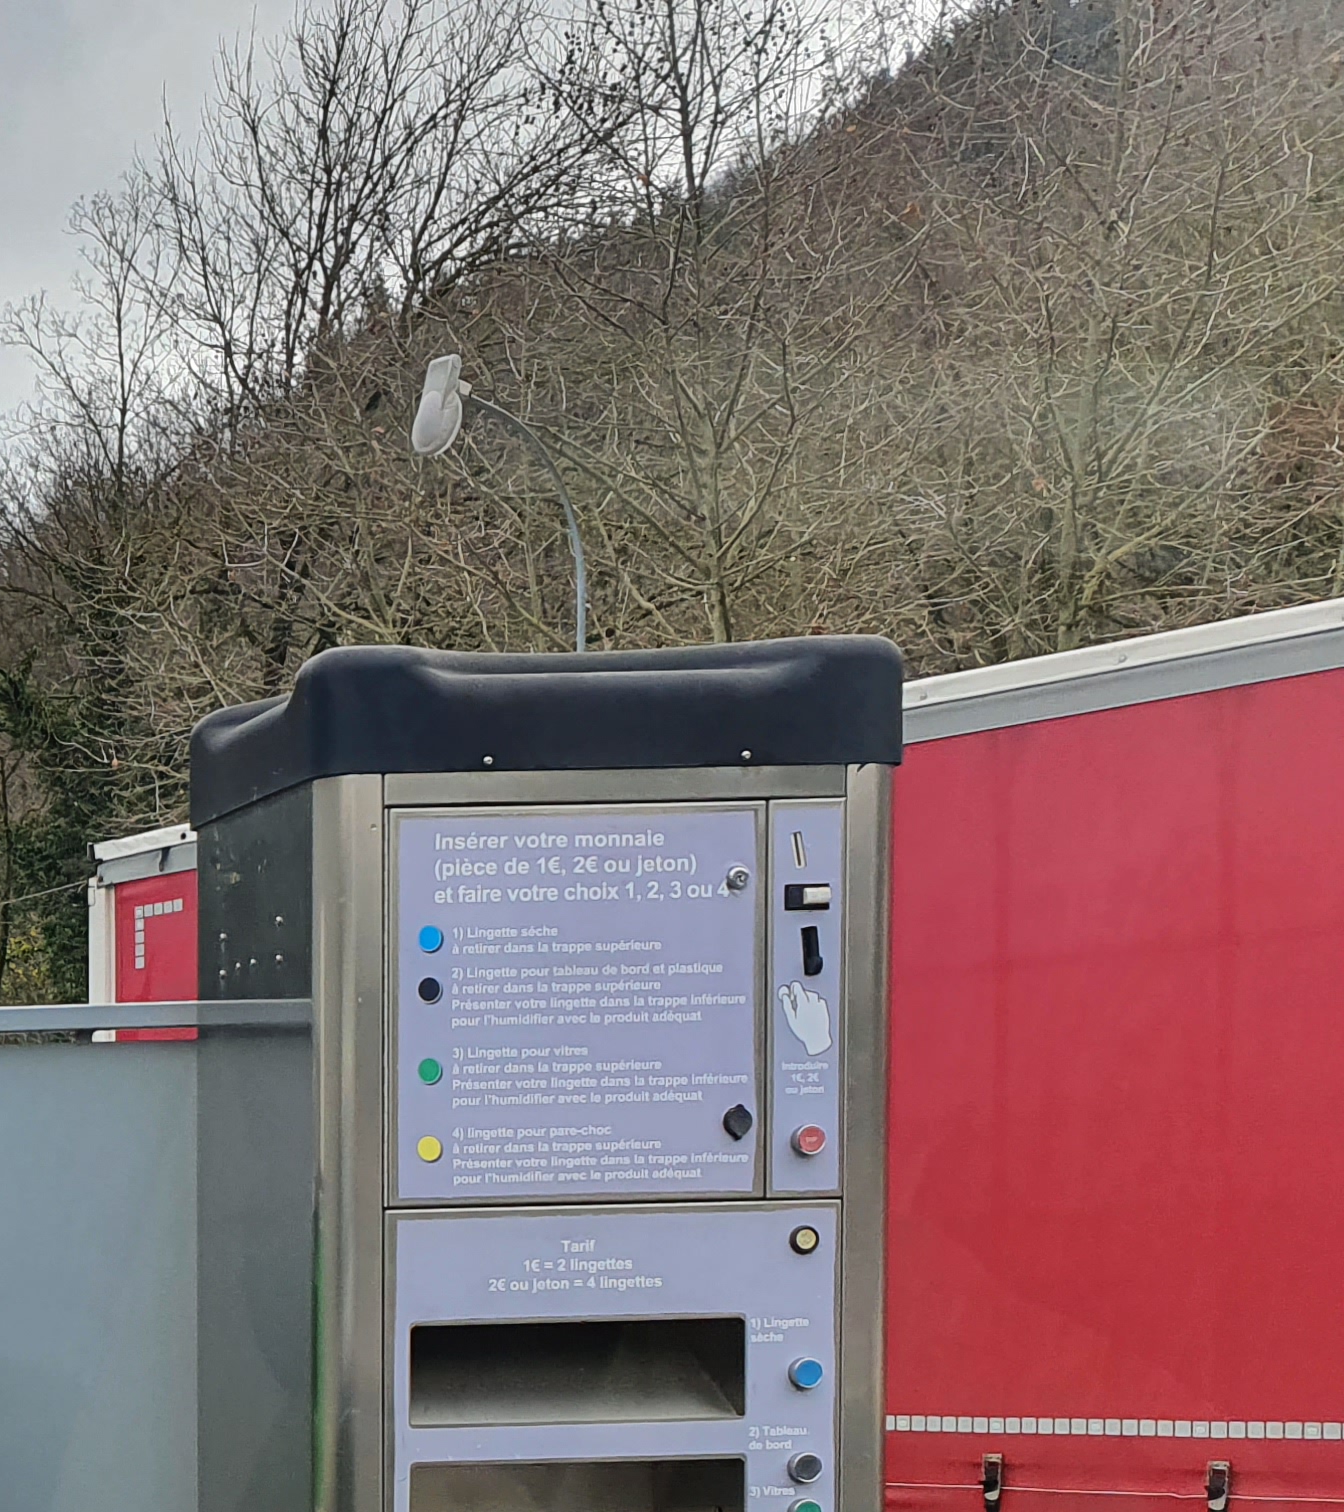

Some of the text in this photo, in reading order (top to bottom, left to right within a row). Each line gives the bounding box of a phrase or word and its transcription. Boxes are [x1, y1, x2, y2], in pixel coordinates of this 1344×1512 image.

[434, 829, 665, 851] Insérer votre monnaie
[434, 853, 698, 882] (pièce de 1€, 2€ ou jeton)
[434, 880, 731, 904] et faire votre choix 1, 2, 3 ou 4
[467, 927, 518, 940] Lingette
[463, 943, 501, 954] retirer
[504, 943, 534, 953] dans
[537, 942, 548, 952] la
[552, 942, 592, 954] trappe
[596, 939, 662, 953] supérieure
[451, 962, 723, 981] 2) Lingette pour tableau de bord et plastique
[463, 983, 500, 994] retirer
[503, 982, 533, 993] dans
[537, 981, 548, 992] la
[552, 982, 591, 994] trappe
[595, 979, 661, 993] supérieure
[451, 998, 512, 1011] Présenter
[515, 999, 546, 1009] votre
[550, 998, 596, 1011] lingette
[599, 996, 630, 1007] dans
[634, 995, 644, 1007] la
[648, 995, 687, 1008] trappe
[451, 1017, 480, 1029] pour
[557, 1015, 586, 1024] avec
[590, 1012, 600, 1023] le
[604, 1011, 649, 1026] produit
[452, 1045, 588, 1060] 3) Lingette pour vitres
[452, 1079, 513, 1090] Présenter
[515, 1078, 547, 1089] votre
[551, 1077, 597, 1090] lingette
[600, 1076, 630, 1087] dans
[634, 1075, 645, 1086] la
[648, 1075, 688, 1088] trappe
[452, 1097, 480, 1109] pour
[557, 1094, 586, 1103] avec
[590, 1092, 601, 1103] le
[604, 1091, 649, 1104] produit
[452, 1127, 464, 1141] 4)
[517, 1127, 546, 1139] pour
[453, 1158, 513, 1169] Présenter
[515, 1157, 547, 1168] votre
[551, 1156, 597, 1169] lingette
[600, 1154, 630, 1165] dans
[634, 1153, 645, 1165] la
[648, 1153, 688, 1166] trappe
[453, 1174, 482, 1186] pour
[557, 1172, 587, 1181] avec
[590, 1169, 601, 1180] le
[604, 1169, 648, 1182] produit
[560, 1239, 596, 1253] Tarif
[523, 1257, 633, 1274] 1€ = 2 lingettes
[488, 1275, 663, 1293] 2€ ou jeton = 4 lingettes
[763, 1317, 810, 1330] Lingette
[749, 1439, 792, 1450] de bord
